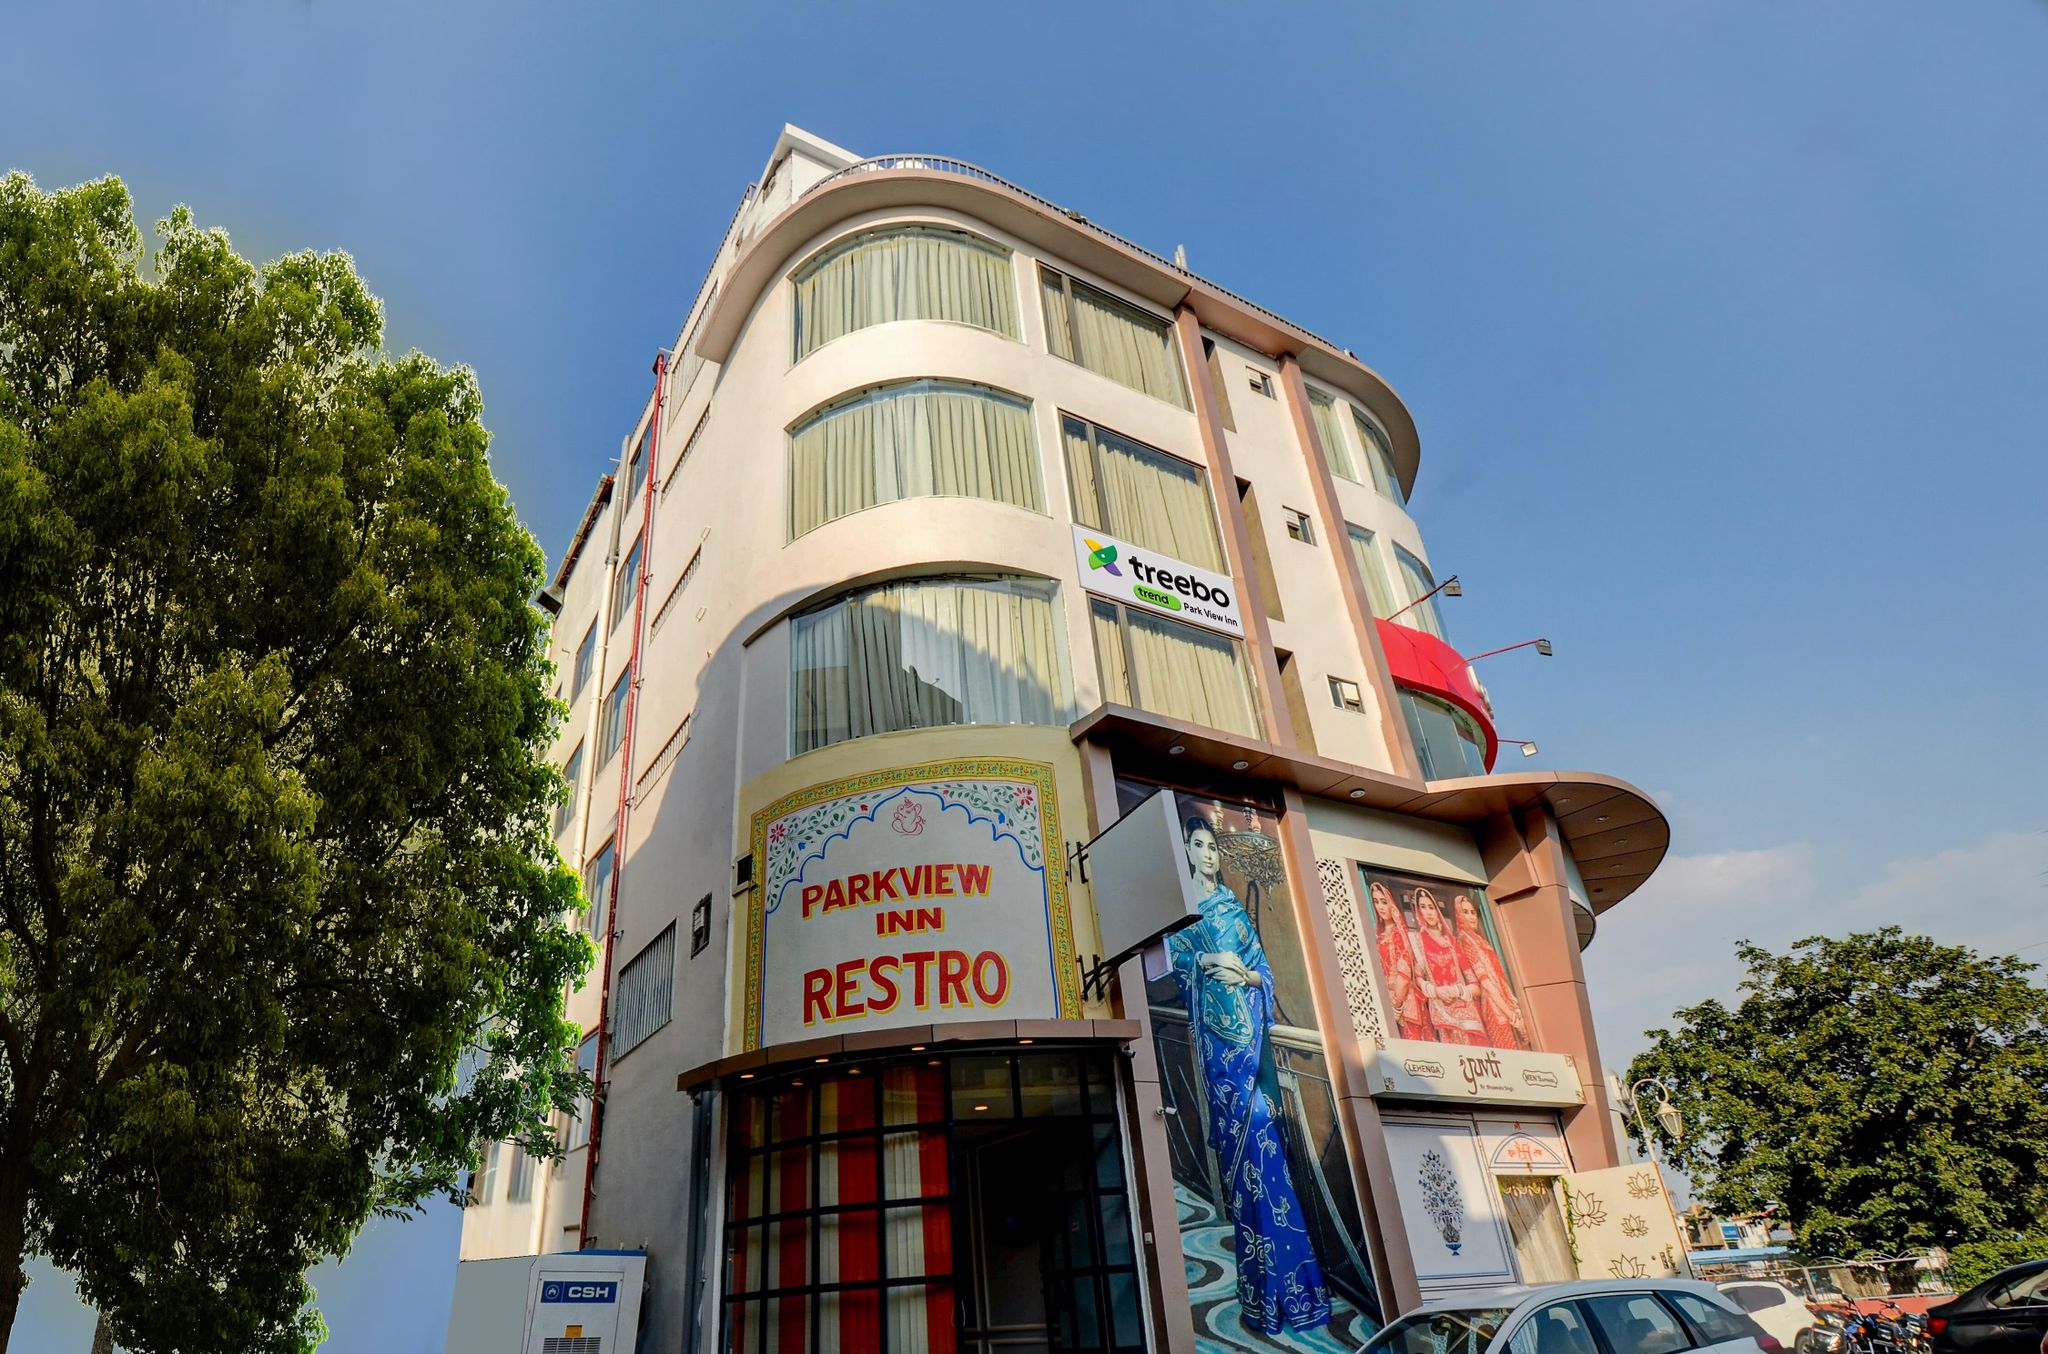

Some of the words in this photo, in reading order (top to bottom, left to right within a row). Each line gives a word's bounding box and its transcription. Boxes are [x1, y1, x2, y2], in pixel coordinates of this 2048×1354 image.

[1128, 555, 1230, 607] treebo
[1137, 587, 1169, 604] trend
[1183, 602, 1203, 615] Park
[1203, 608, 1223, 623] View
[1224, 615, 1238, 627] Inn
[802, 864, 991, 919] PARKVIEW
[876, 907, 944, 937] INN
[803, 950, 1010, 1027] RESTRO
[1407, 1064, 1441, 1074] LEHENGA
[568, 1286, 610, 1298] CSH
